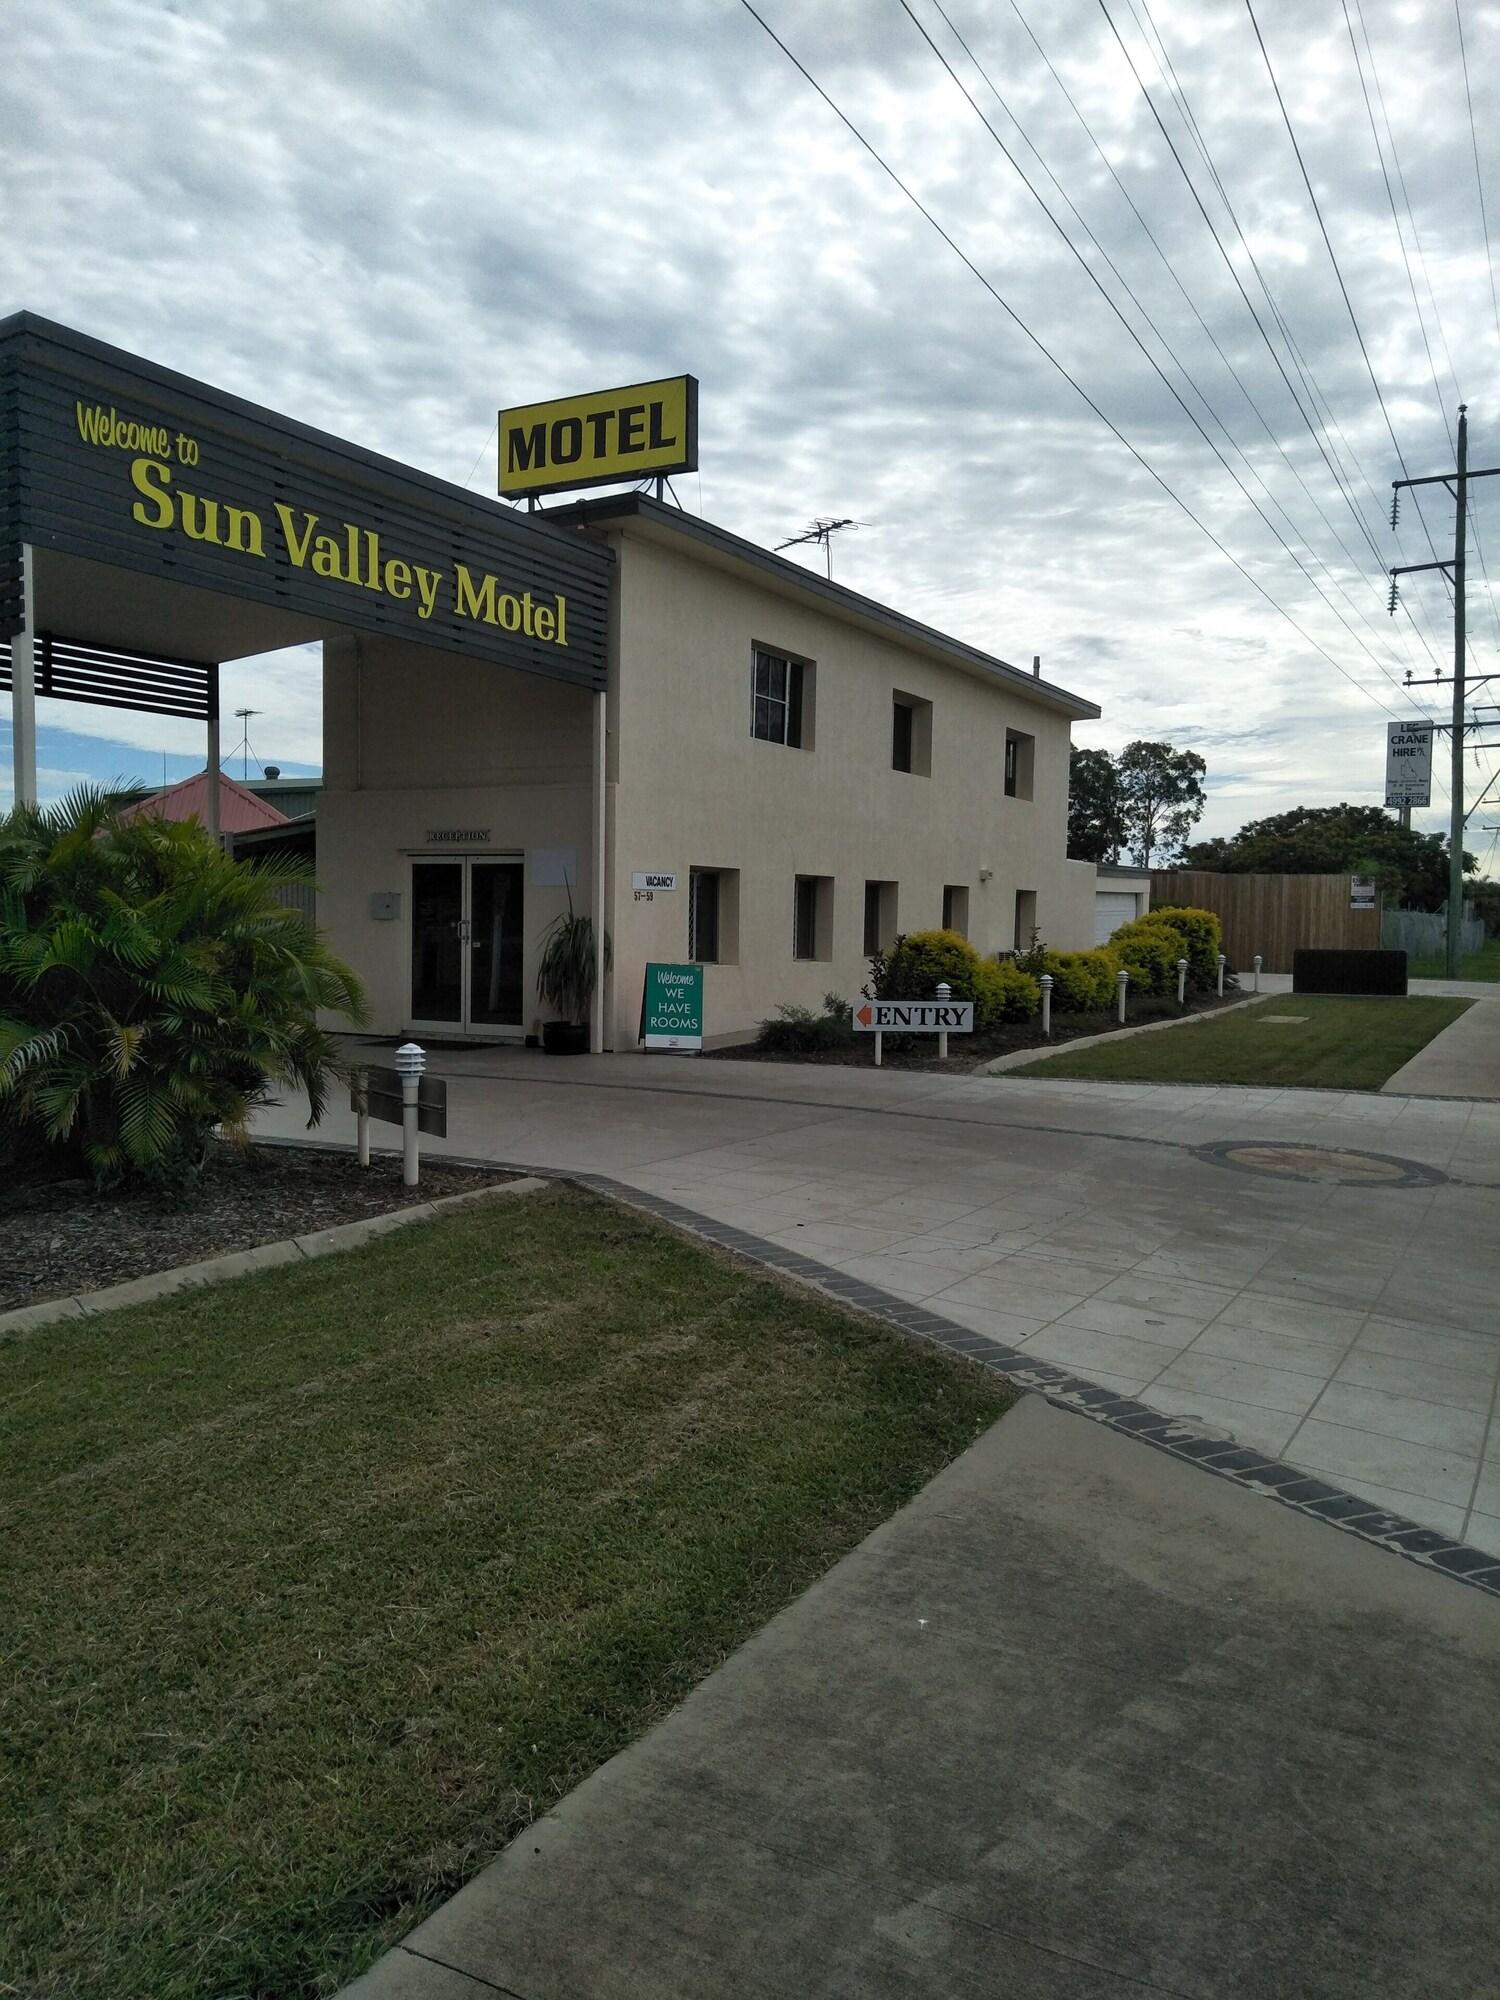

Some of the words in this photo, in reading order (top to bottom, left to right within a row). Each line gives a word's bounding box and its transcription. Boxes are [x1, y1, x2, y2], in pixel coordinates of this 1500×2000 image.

[76, 400, 171, 458] Welcome
[175, 432, 199, 466] to
[508, 401, 677, 473] MOTEL
[131, 458, 266, 558] Sun
[273, 502, 442, 619] Valley
[454, 563, 568, 646] Motel
[1391, 735, 1428, 744] CRANE
[1393, 748, 1416, 757] HIRE
[428, 831, 487, 841] RECEPTION
[645, 875, 674, 888] VACANCY
[657, 971, 694, 986] Welcome
[665, 988, 685, 999] WE
[658, 1002, 691, 1014] HAVE
[650, 1016, 698, 1029] ROOMS
[875, 1006, 968, 1026] ENTRY
